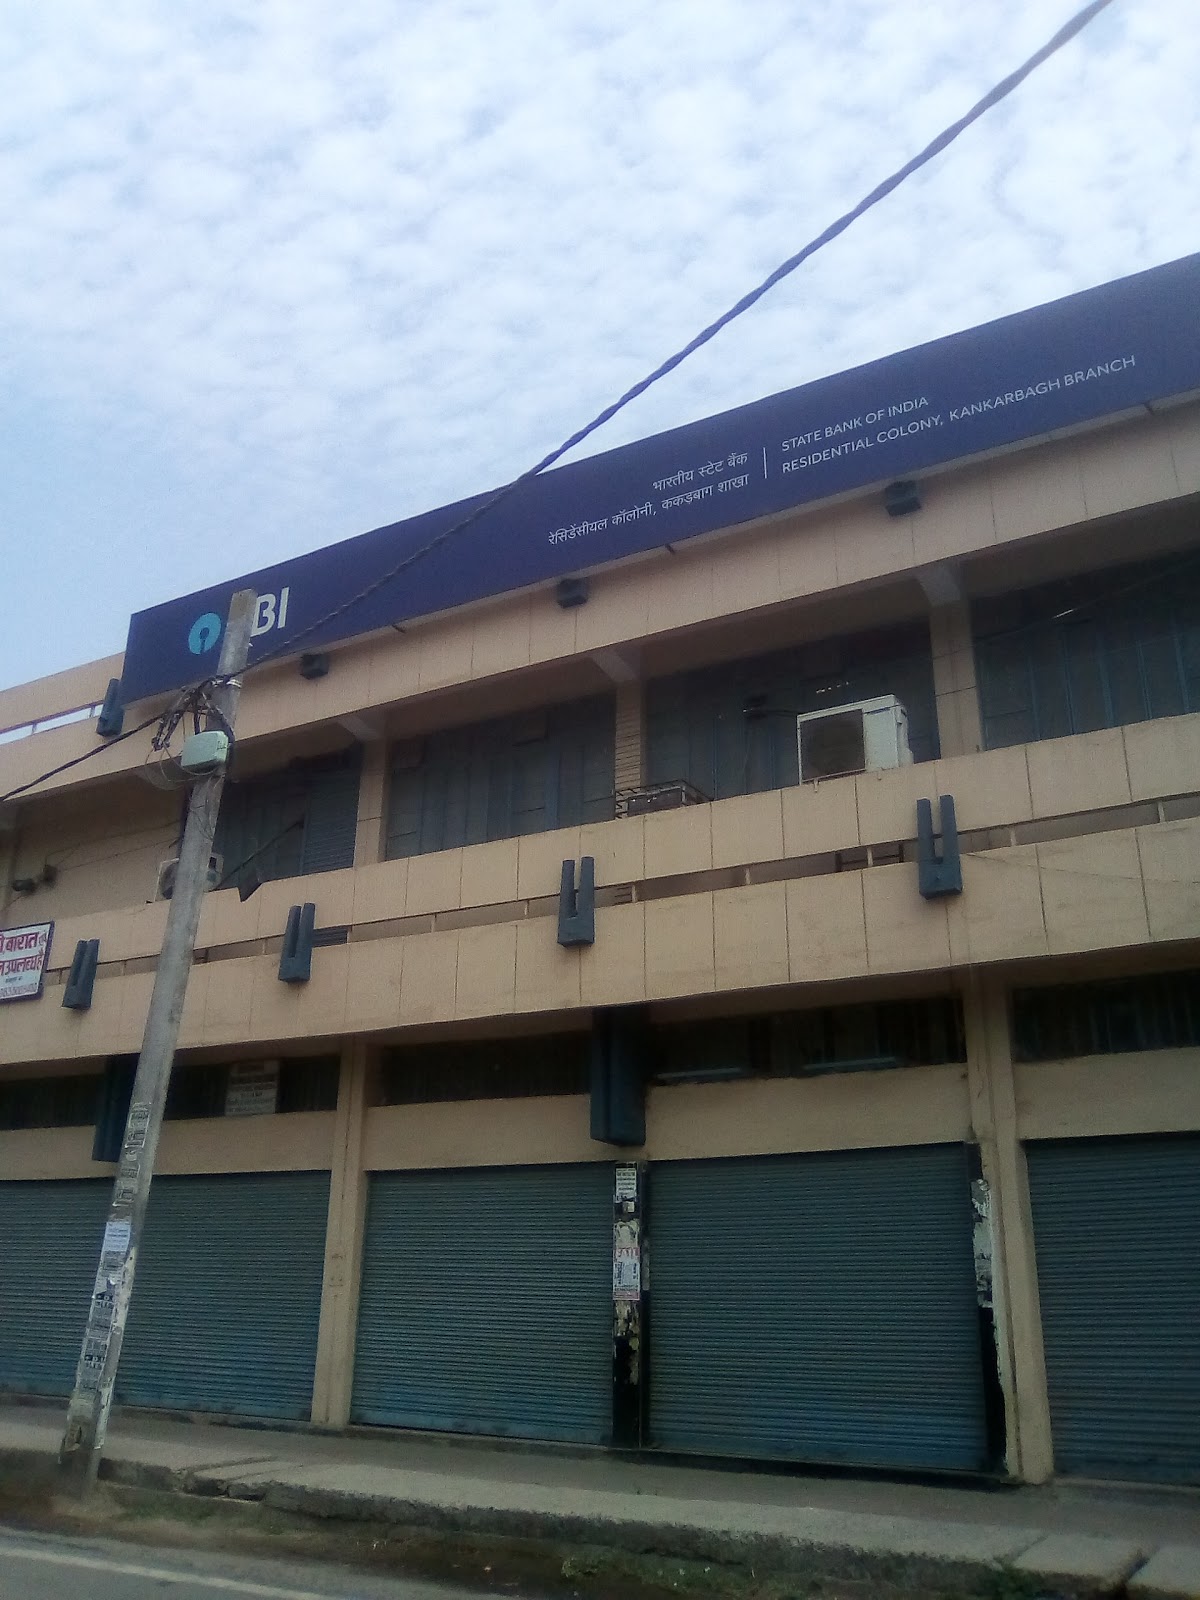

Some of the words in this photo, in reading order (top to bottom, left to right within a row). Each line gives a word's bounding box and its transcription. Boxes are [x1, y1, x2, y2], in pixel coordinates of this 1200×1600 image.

[781, 429, 823, 453] STATE
[824, 416, 863, 438] BANK
[865, 409, 885, 424] OF
[887, 396, 929, 418] INDIA
[782, 438, 875, 474] RESIDENTIAL
[876, 415, 943, 443] COLONY,
[949, 378, 1061, 422] KANKARBAGH
[1063, 355, 1136, 387] BRANCH
[651, 469, 695, 491] भारतीय
[697, 460, 725, 478] स्टेट
[726, 452, 750, 468] बैंक
[548, 517, 609, 545] रेसिडेंसीयल
[612, 501, 657, 526] कॉलोनी,
[661, 484, 714, 511] ककड़बाग
[717, 473, 750, 493] शाखा
[248, 586, 290, 638] BI
